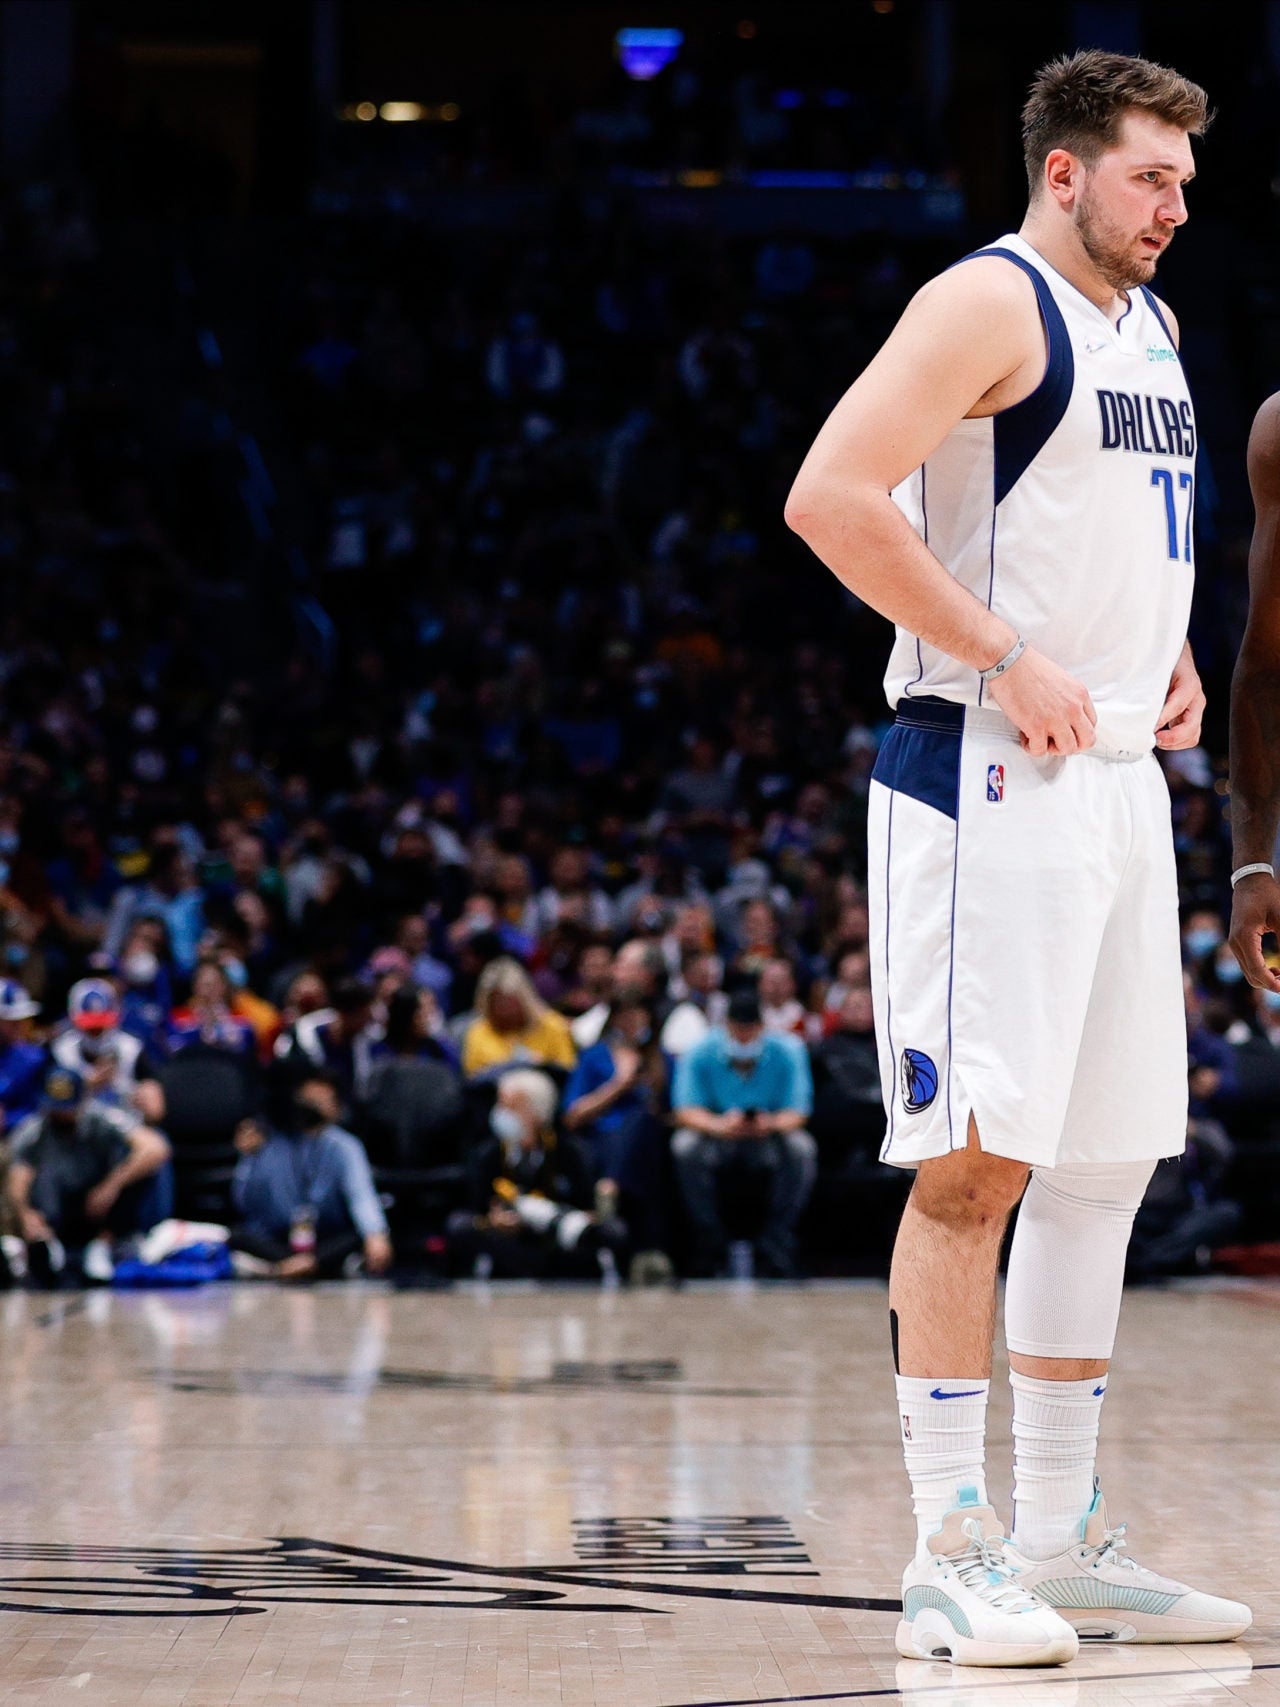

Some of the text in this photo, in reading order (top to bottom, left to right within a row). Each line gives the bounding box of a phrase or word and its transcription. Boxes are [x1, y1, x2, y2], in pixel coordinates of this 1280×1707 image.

[1146, 345, 1177, 362] chime
[1096, 389, 1194, 457] DALLAS
[1150, 467, 1193, 564] 77
